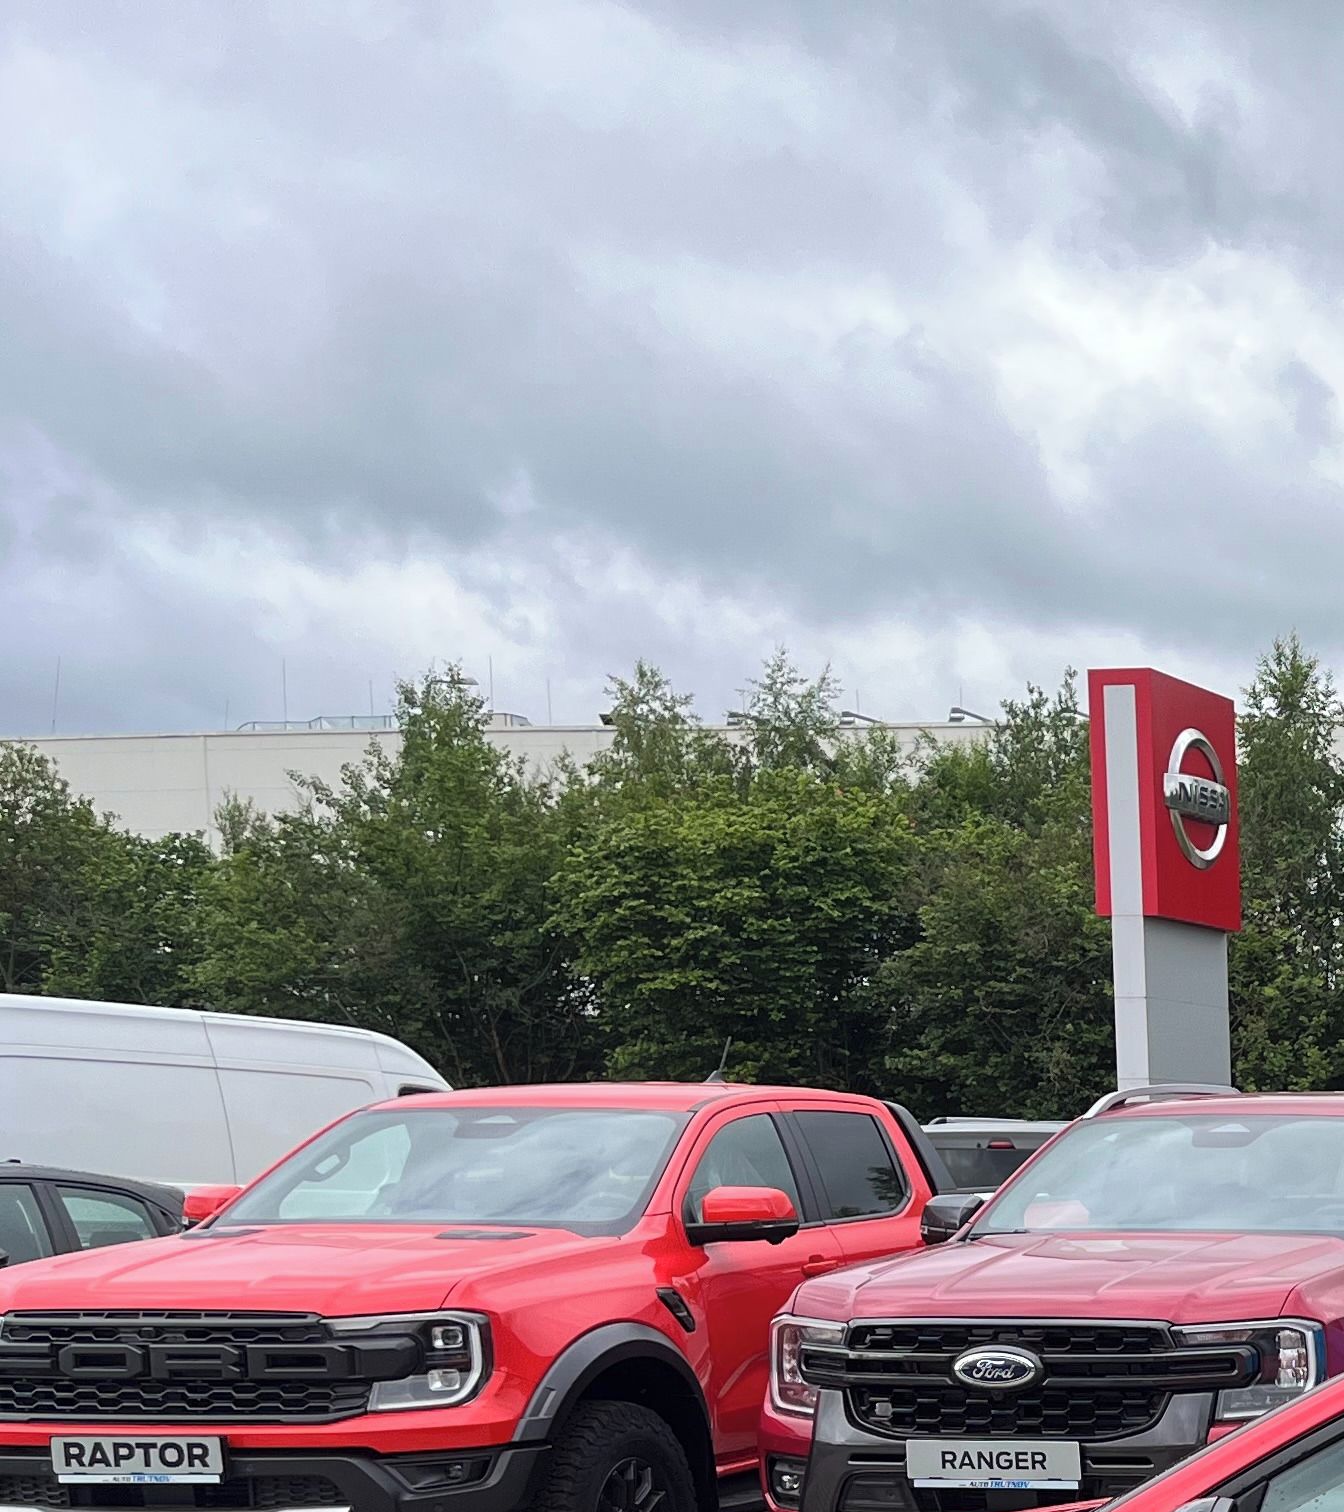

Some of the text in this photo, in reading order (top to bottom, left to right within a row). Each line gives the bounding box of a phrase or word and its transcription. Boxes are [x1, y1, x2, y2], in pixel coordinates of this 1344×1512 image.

[973, 1359, 1015, 1379] Ford
[63, 1442, 210, 1468] RAPTOR
[941, 1451, 1047, 1470] RANGER
